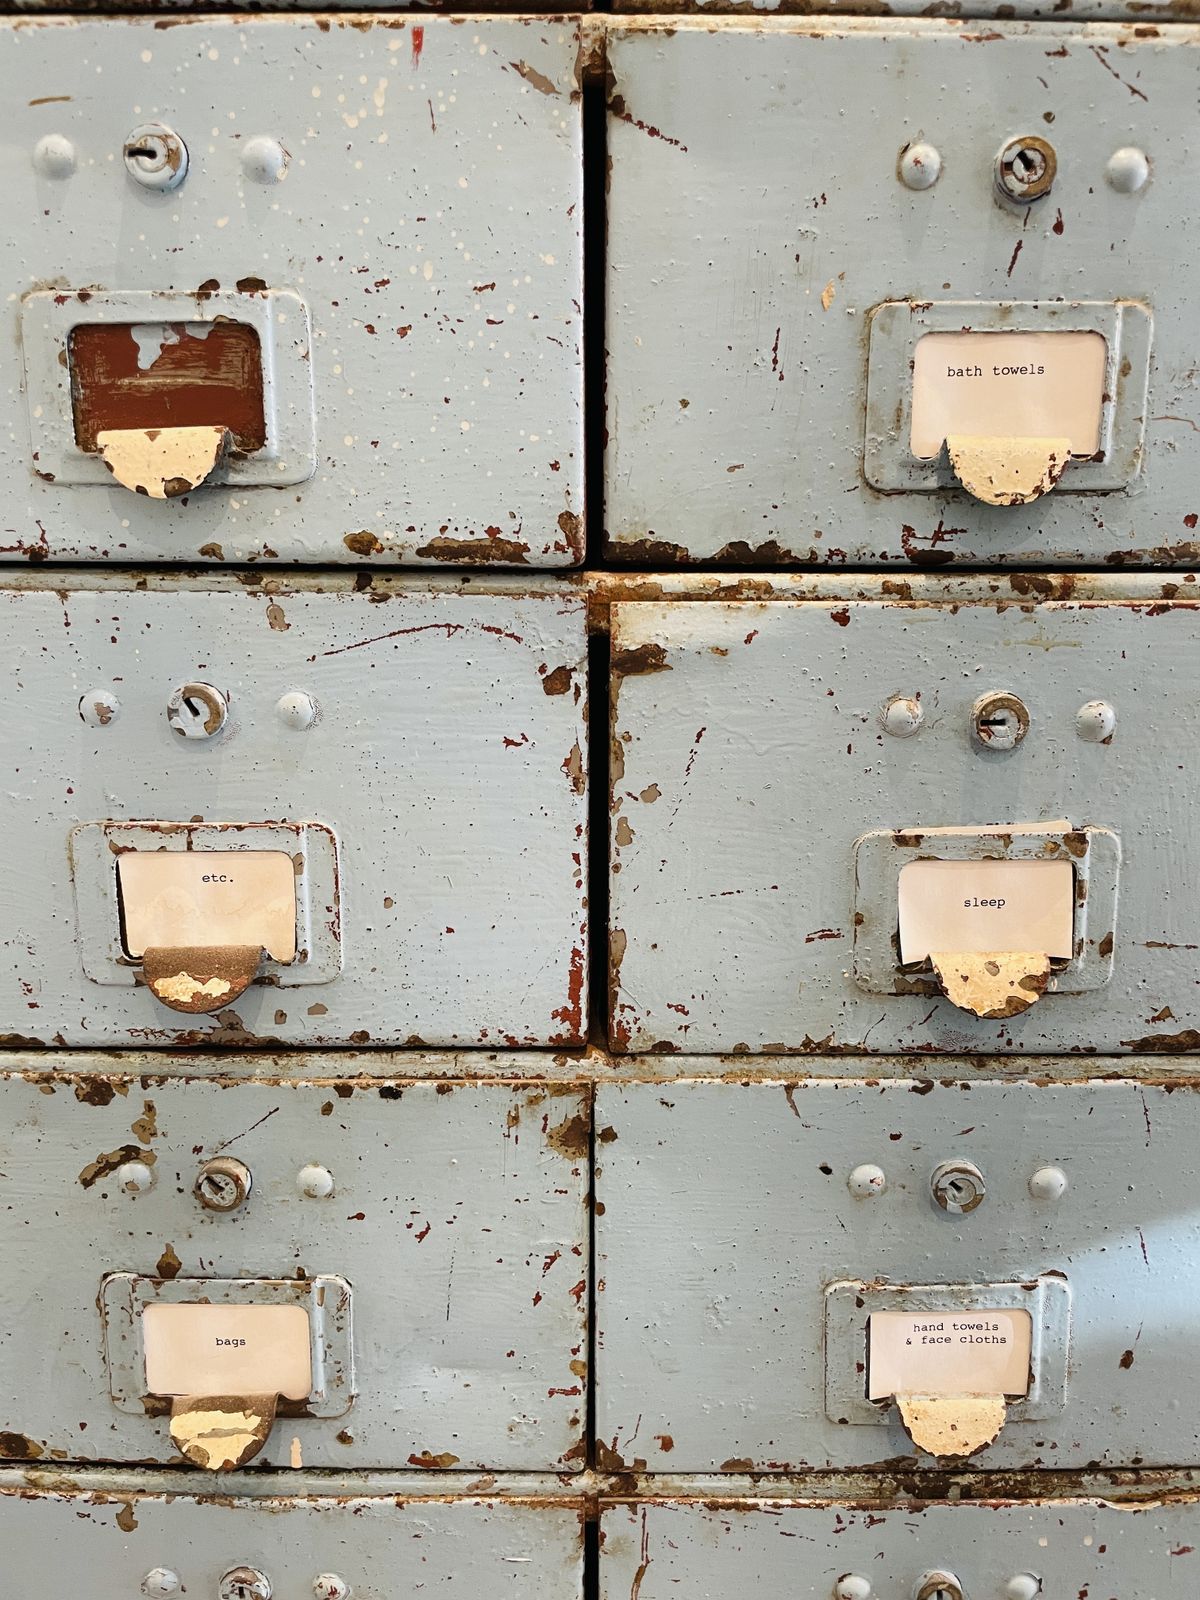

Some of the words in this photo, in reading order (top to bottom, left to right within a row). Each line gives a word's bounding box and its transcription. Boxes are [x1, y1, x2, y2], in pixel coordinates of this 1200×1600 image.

[947, 366, 982, 377] bath
[993, 364, 1045, 375] towels
[202, 873, 233, 882] etc.
[963, 897, 1005, 909] sleep
[913, 1322, 943, 1332] hand
[952, 1321, 998, 1331] towels
[215, 1337, 246, 1348] bags
[905, 1337, 912, 1345] &
[921, 1335, 951, 1344] face
[959, 1334, 1006, 1344] cloths
